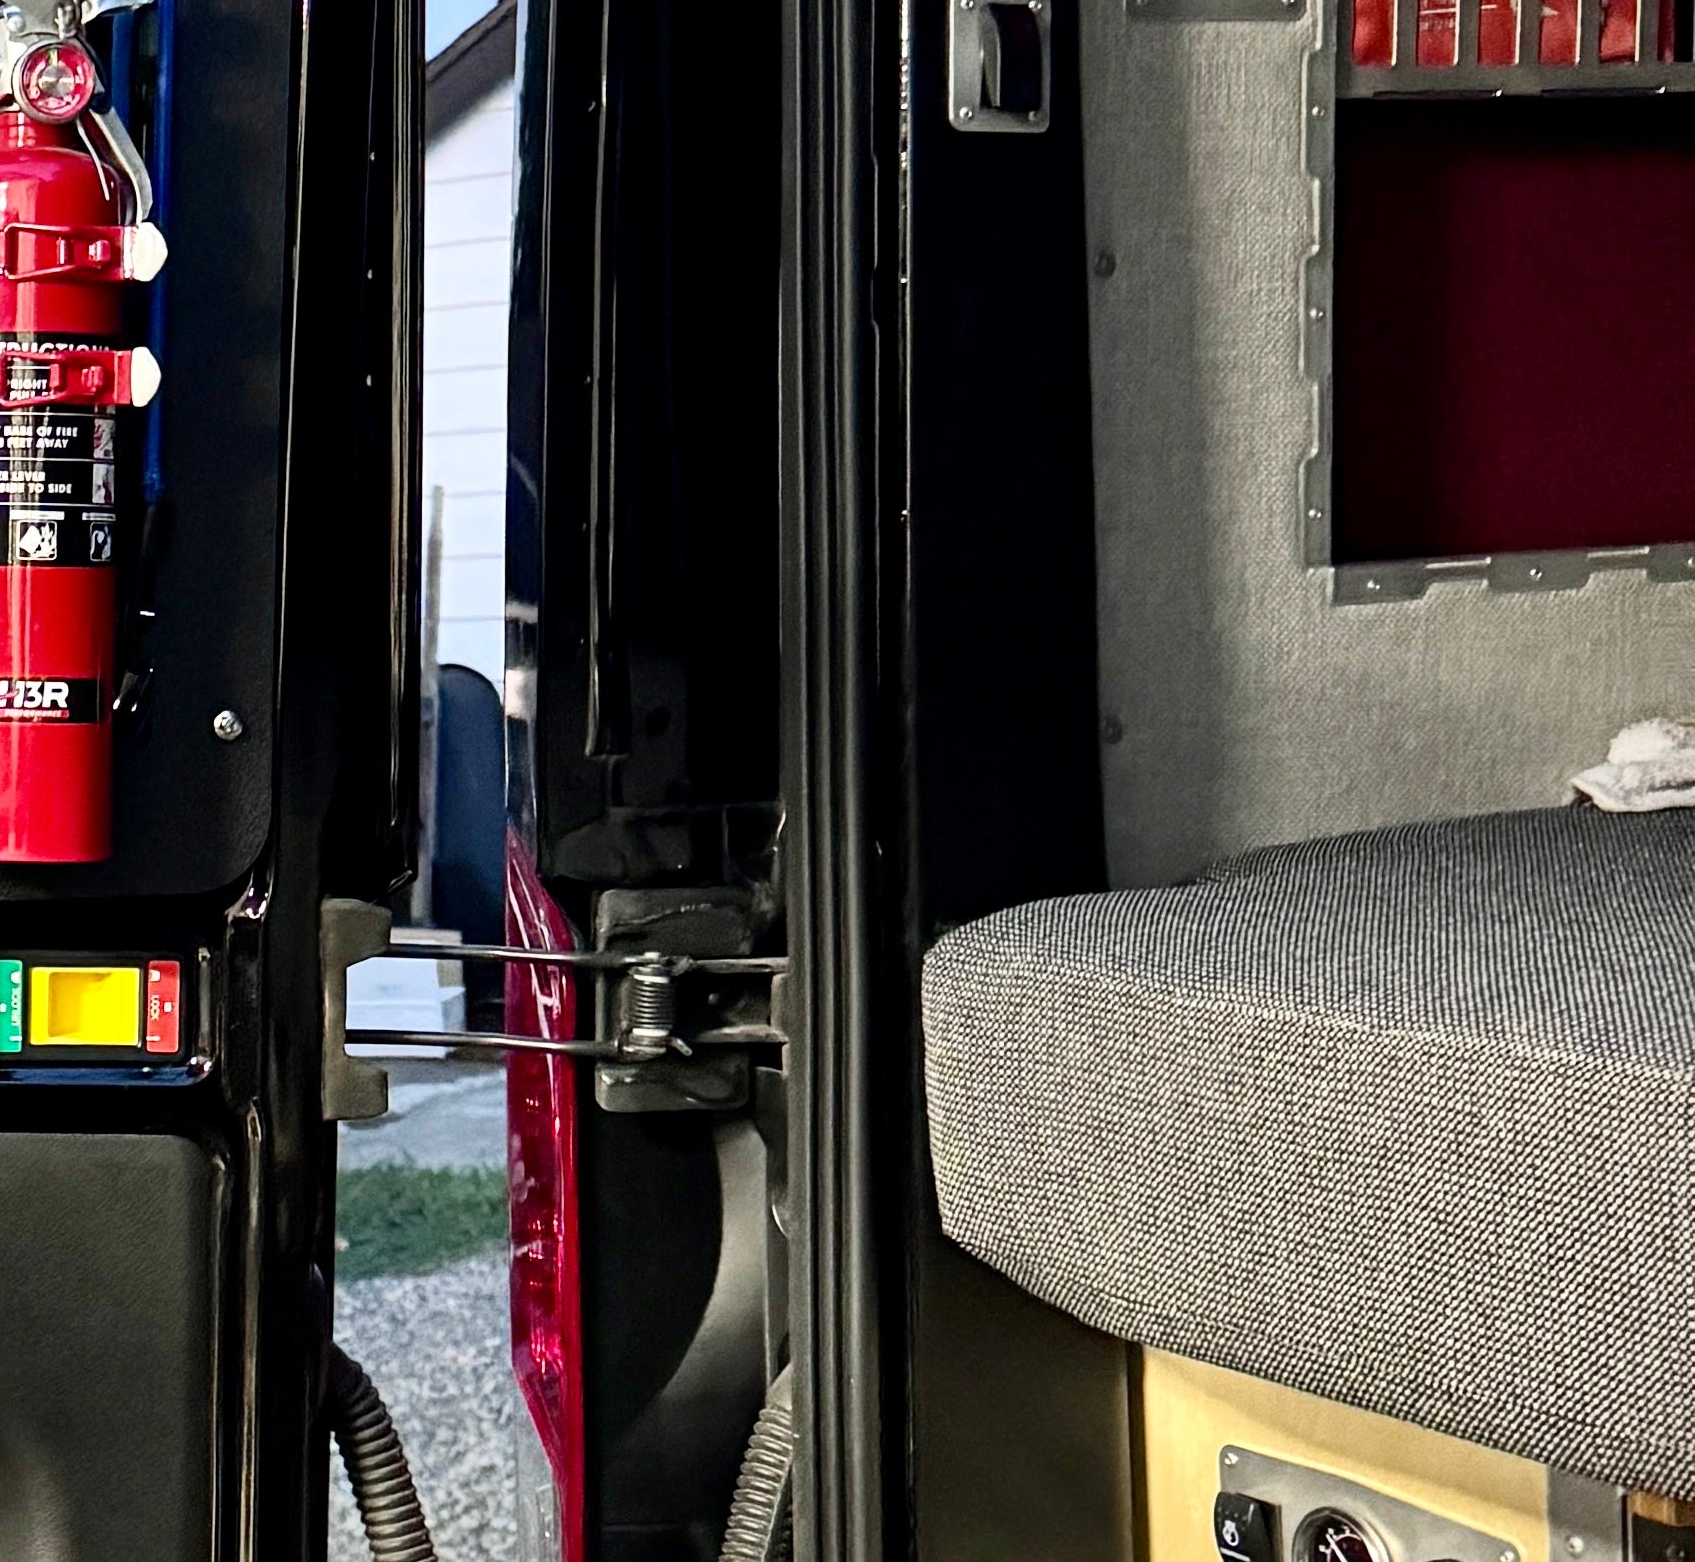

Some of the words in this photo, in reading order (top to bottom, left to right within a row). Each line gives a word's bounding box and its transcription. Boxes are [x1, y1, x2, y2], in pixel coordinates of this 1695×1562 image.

[36, 426, 53, 437] OF
[36, 438, 69, 449] AWAY
[27, 483, 45, 493] TO
[48, 483, 73, 494] SIDE
[148, 994, 160, 1022] LOCK
